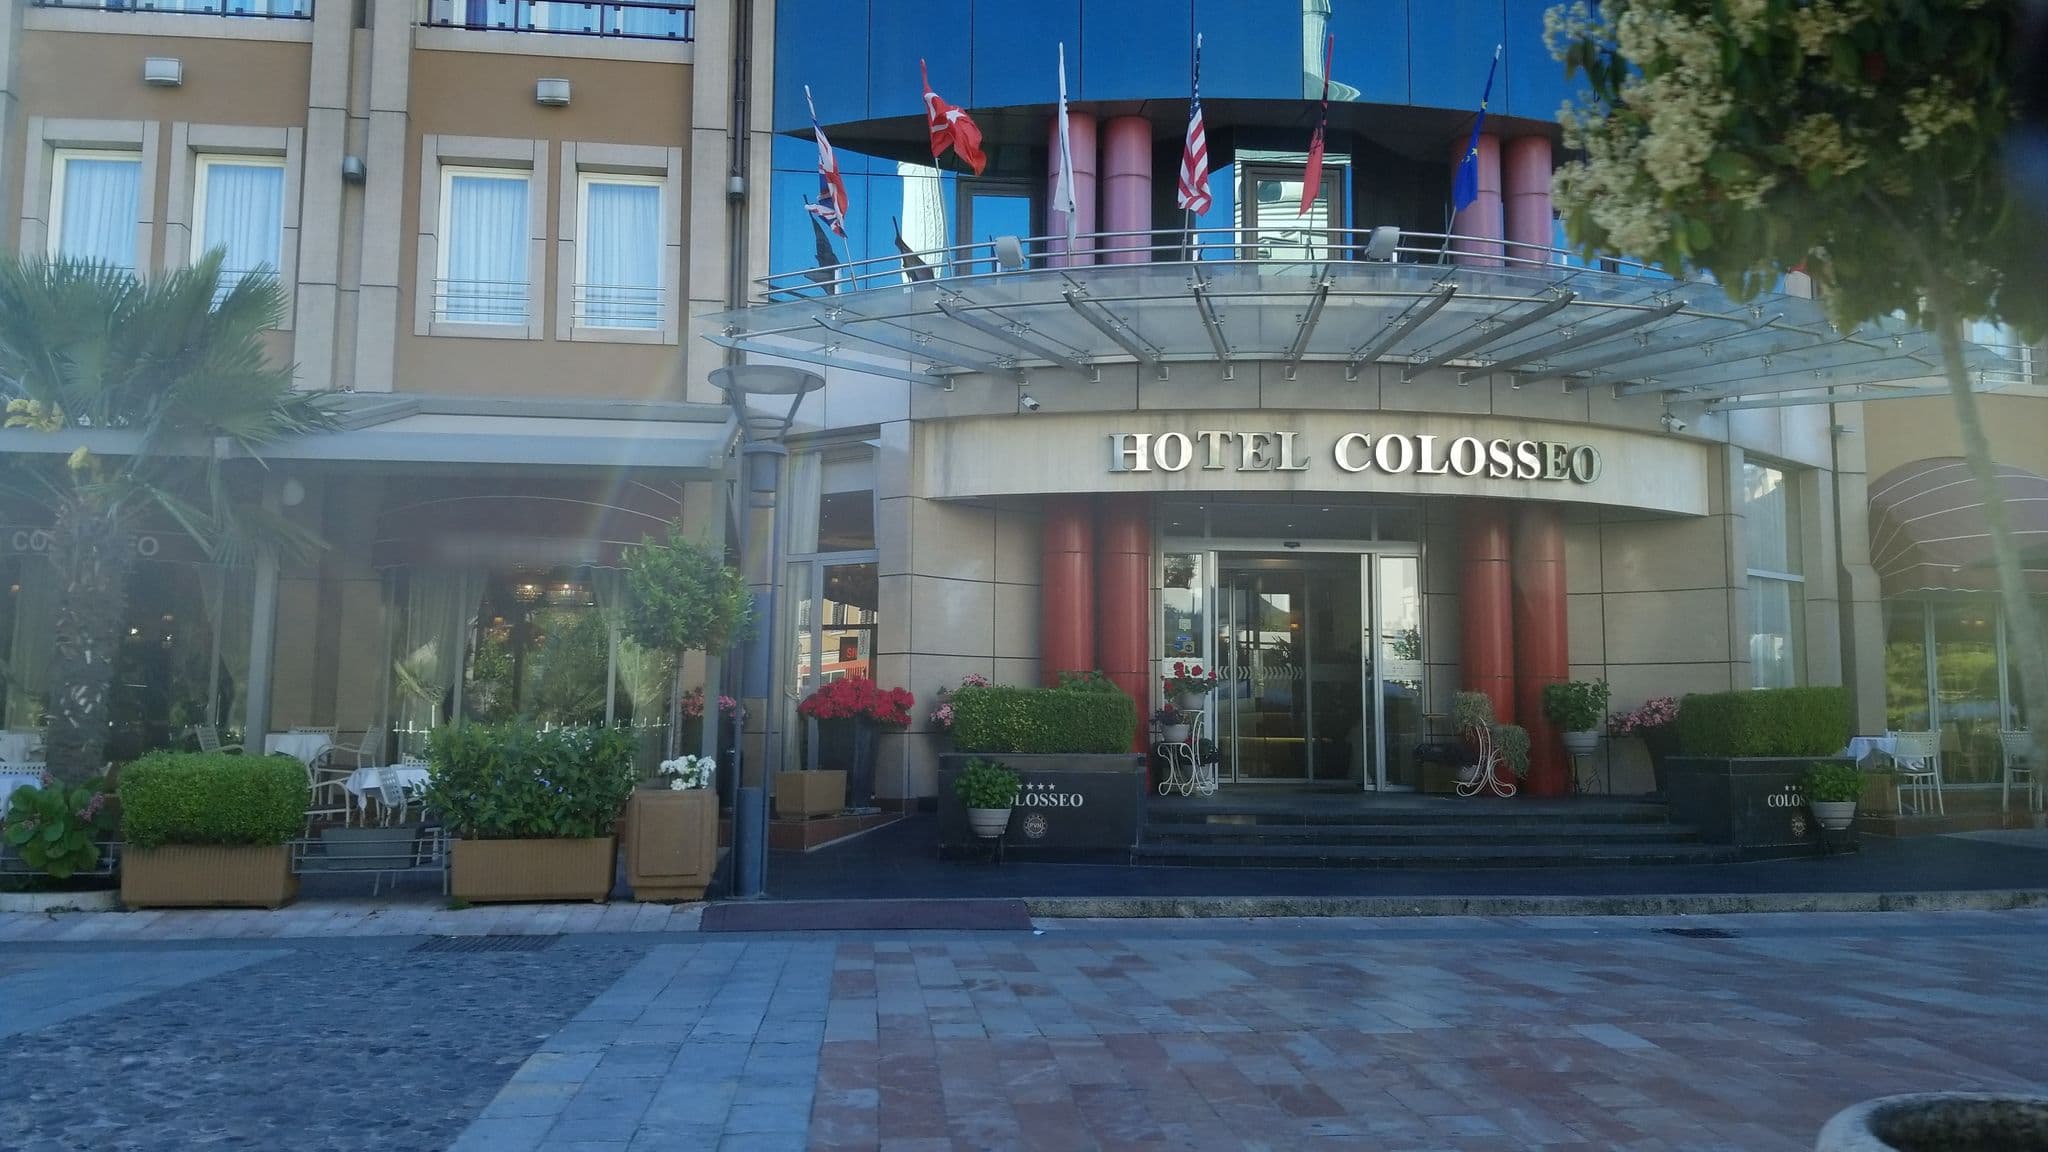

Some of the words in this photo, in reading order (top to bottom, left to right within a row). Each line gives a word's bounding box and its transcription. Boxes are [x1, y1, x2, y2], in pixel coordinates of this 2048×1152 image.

[1107, 430, 1312, 473] HOTEL
[1334, 432, 1602, 484] COLOSSEO
[1010, 792, 1084, 807] LOSSEO
